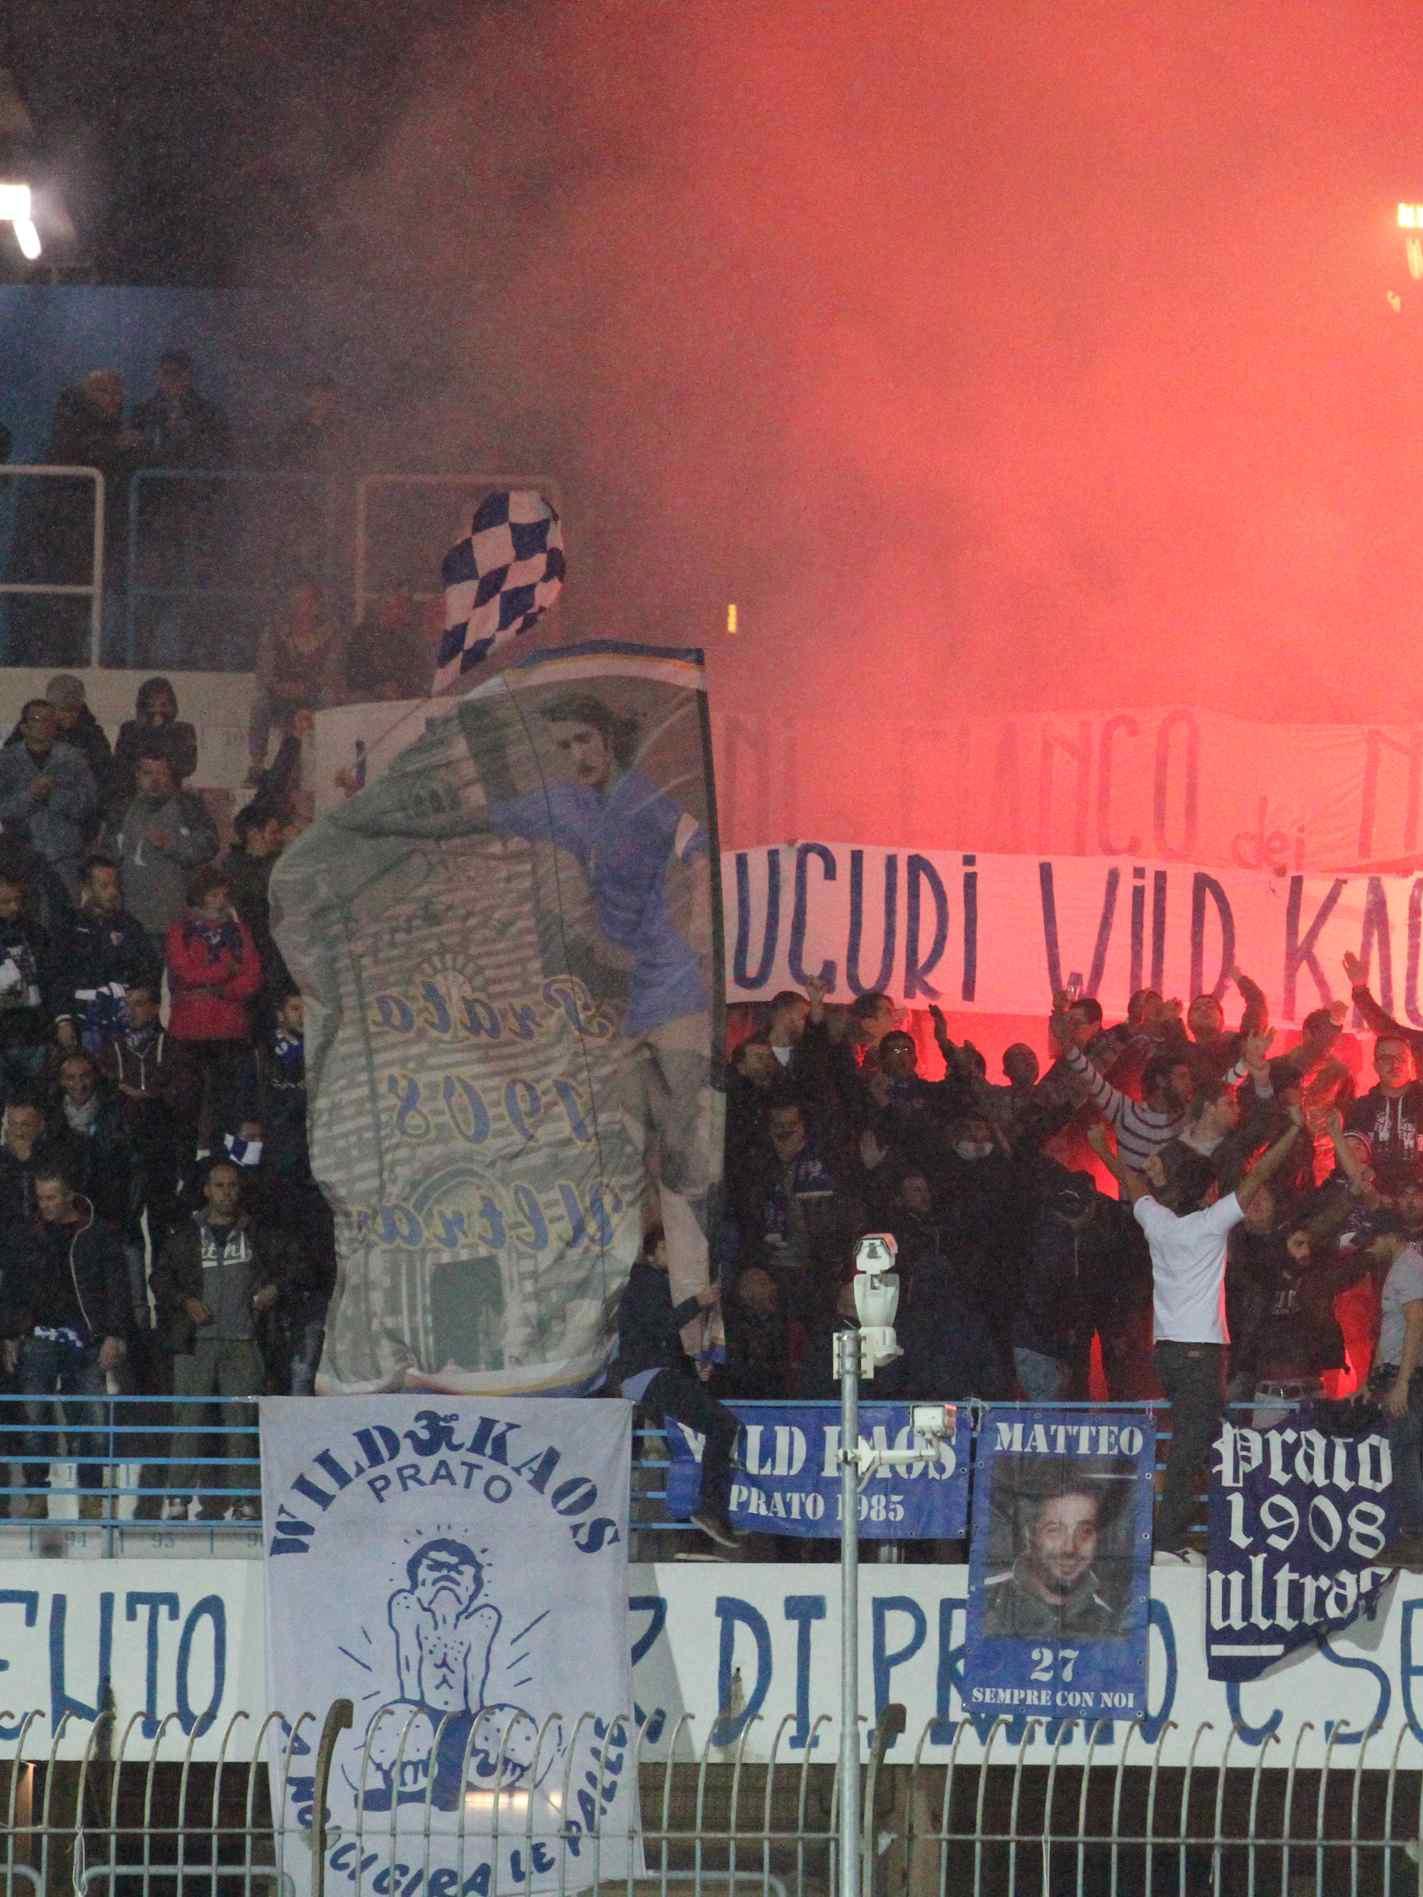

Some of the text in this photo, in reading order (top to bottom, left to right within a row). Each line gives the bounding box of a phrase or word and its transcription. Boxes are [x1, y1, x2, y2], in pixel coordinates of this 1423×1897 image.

[995, 1422, 1144, 1456] MATTEO
[270, 1415, 621, 1556] WILD KAOS
[367, 1459, 513, 1504] PRATO
[728, 1484, 825, 1521] PRATO
[1226, 1491, 1387, 1559] 1908
[712, 1595, 827, 1748] DI
[1030, 1647, 1079, 1682] 27
[971, 1687, 1136, 1709] SEMPRE CON NOI
